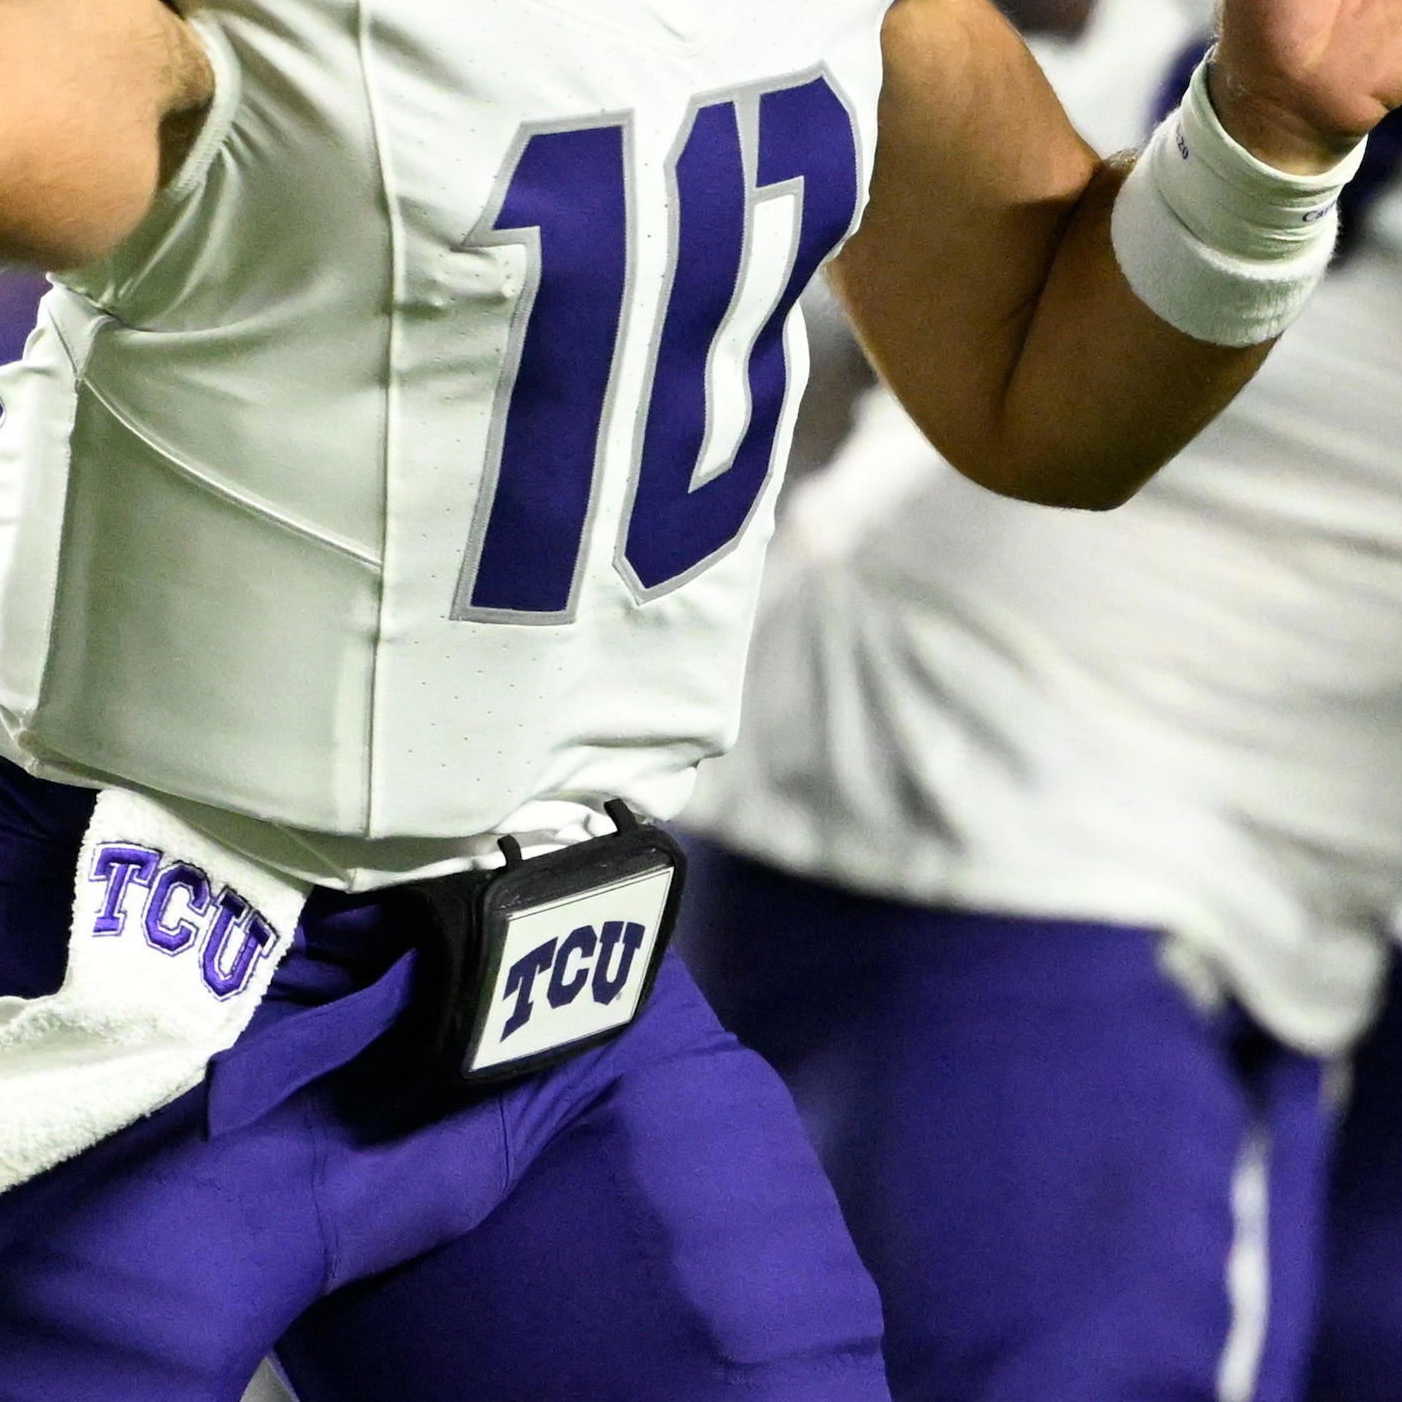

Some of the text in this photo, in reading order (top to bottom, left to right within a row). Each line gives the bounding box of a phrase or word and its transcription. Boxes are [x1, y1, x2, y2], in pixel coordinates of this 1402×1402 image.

[450, 60, 864, 626] 10
[87, 841, 282, 1002] TCU
[500, 919, 648, 1043] TCU
